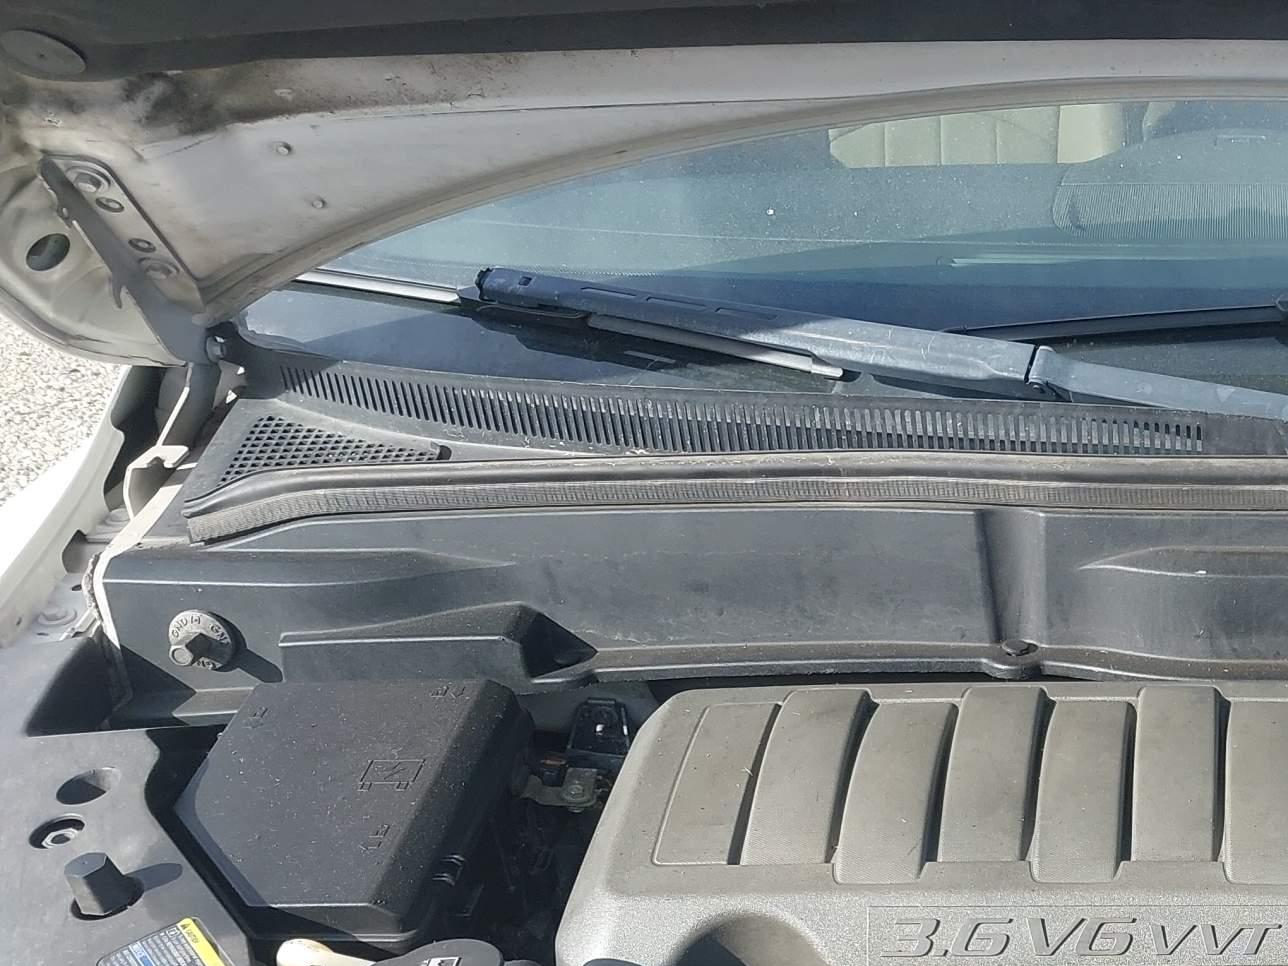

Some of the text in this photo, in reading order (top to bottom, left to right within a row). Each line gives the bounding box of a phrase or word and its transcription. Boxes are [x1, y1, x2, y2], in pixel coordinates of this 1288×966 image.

[171, 617, 188, 638] GND
[880, 916, 1283, 958] 3.6 V6 VVT
